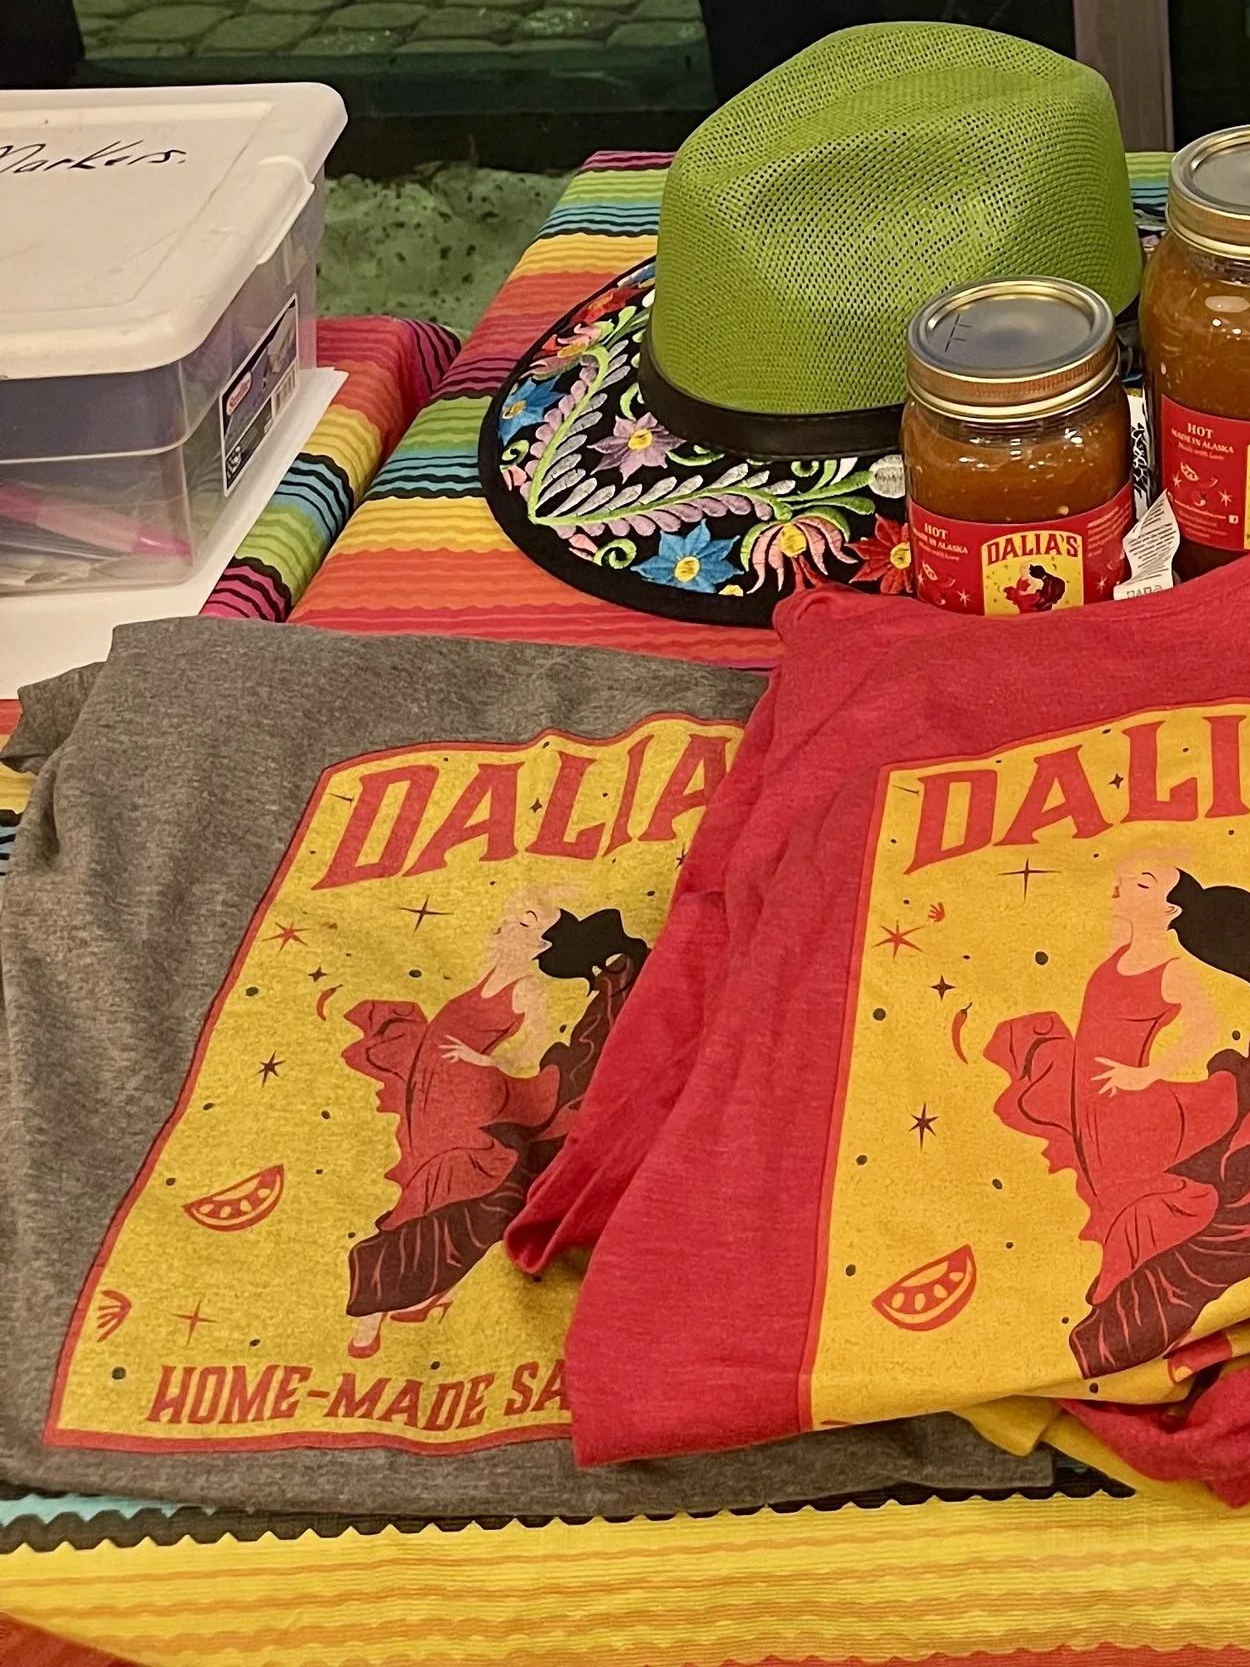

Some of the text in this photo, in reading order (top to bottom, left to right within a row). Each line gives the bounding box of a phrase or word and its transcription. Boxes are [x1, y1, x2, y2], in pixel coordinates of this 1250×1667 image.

[1187, 423, 1214, 439] HOT
[924, 522, 948, 540] HOT
[986, 533, 1079, 566] DALIA'S
[310, 733, 731, 891] DALIA
[146, 1364, 496, 1432] HOME-MADE
